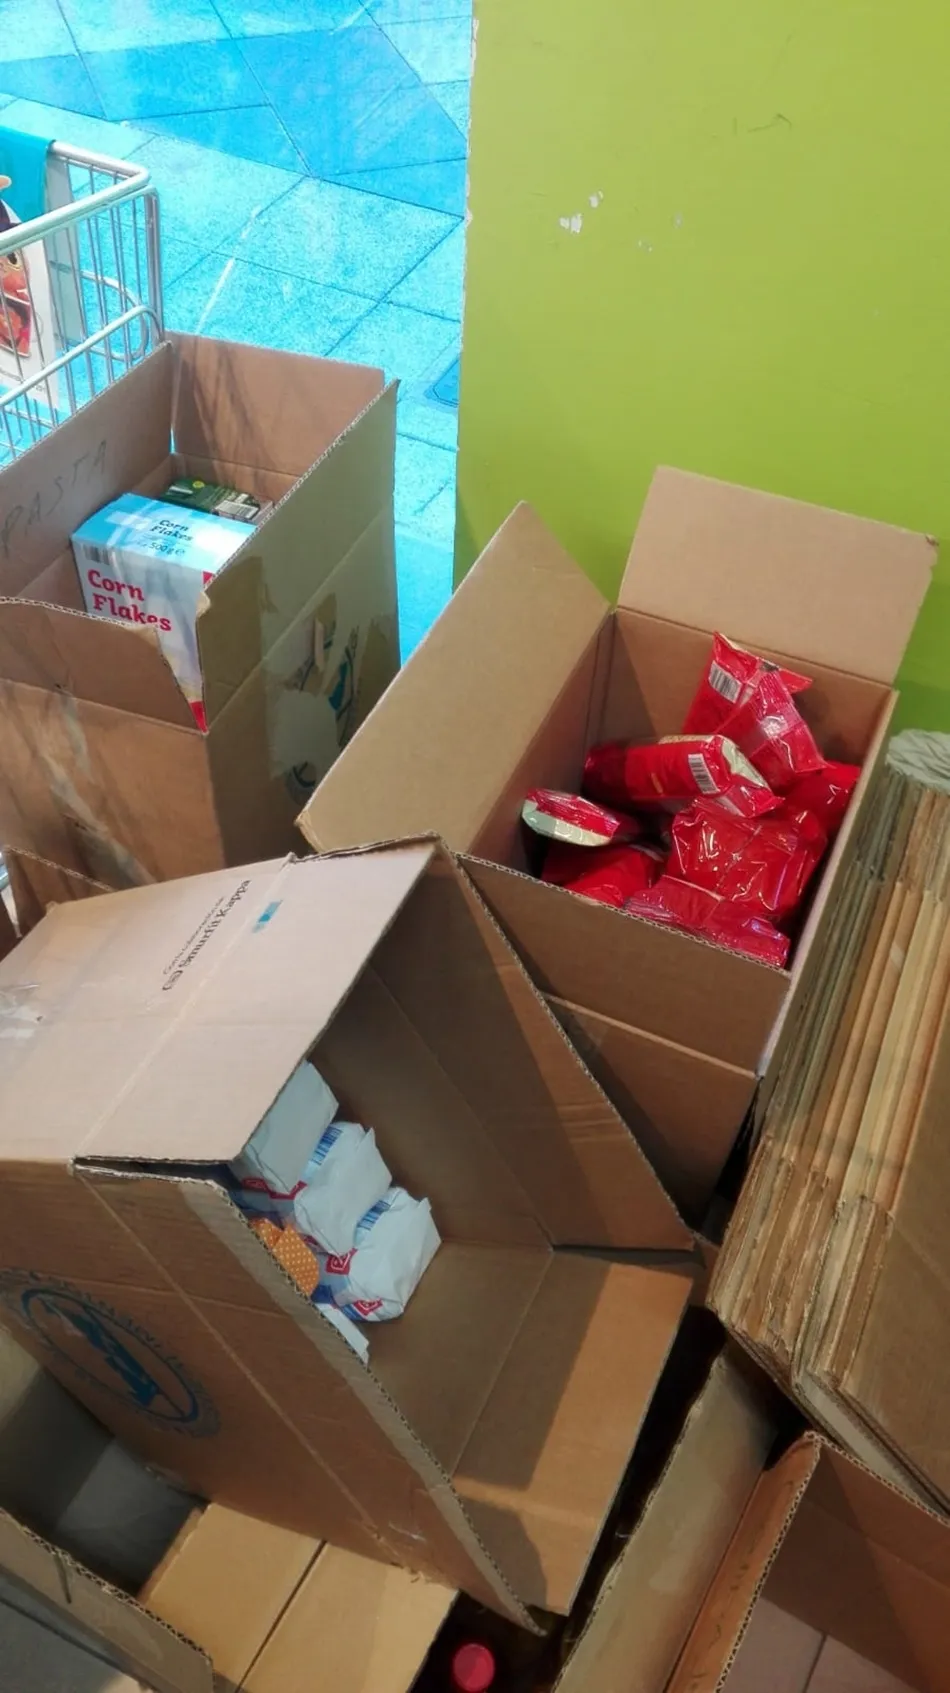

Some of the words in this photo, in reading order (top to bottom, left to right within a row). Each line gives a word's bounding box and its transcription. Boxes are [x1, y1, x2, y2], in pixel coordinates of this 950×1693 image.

[1, 440, 107, 559] PASTA
[150, 526, 193, 541] Flakes
[159, 519, 189, 531] Corn
[87, 568, 145, 602] Corn
[92, 592, 172, 632] Flakes
[178, 918, 222, 968] Smurfit
[215, 879, 251, 920] Kappa
